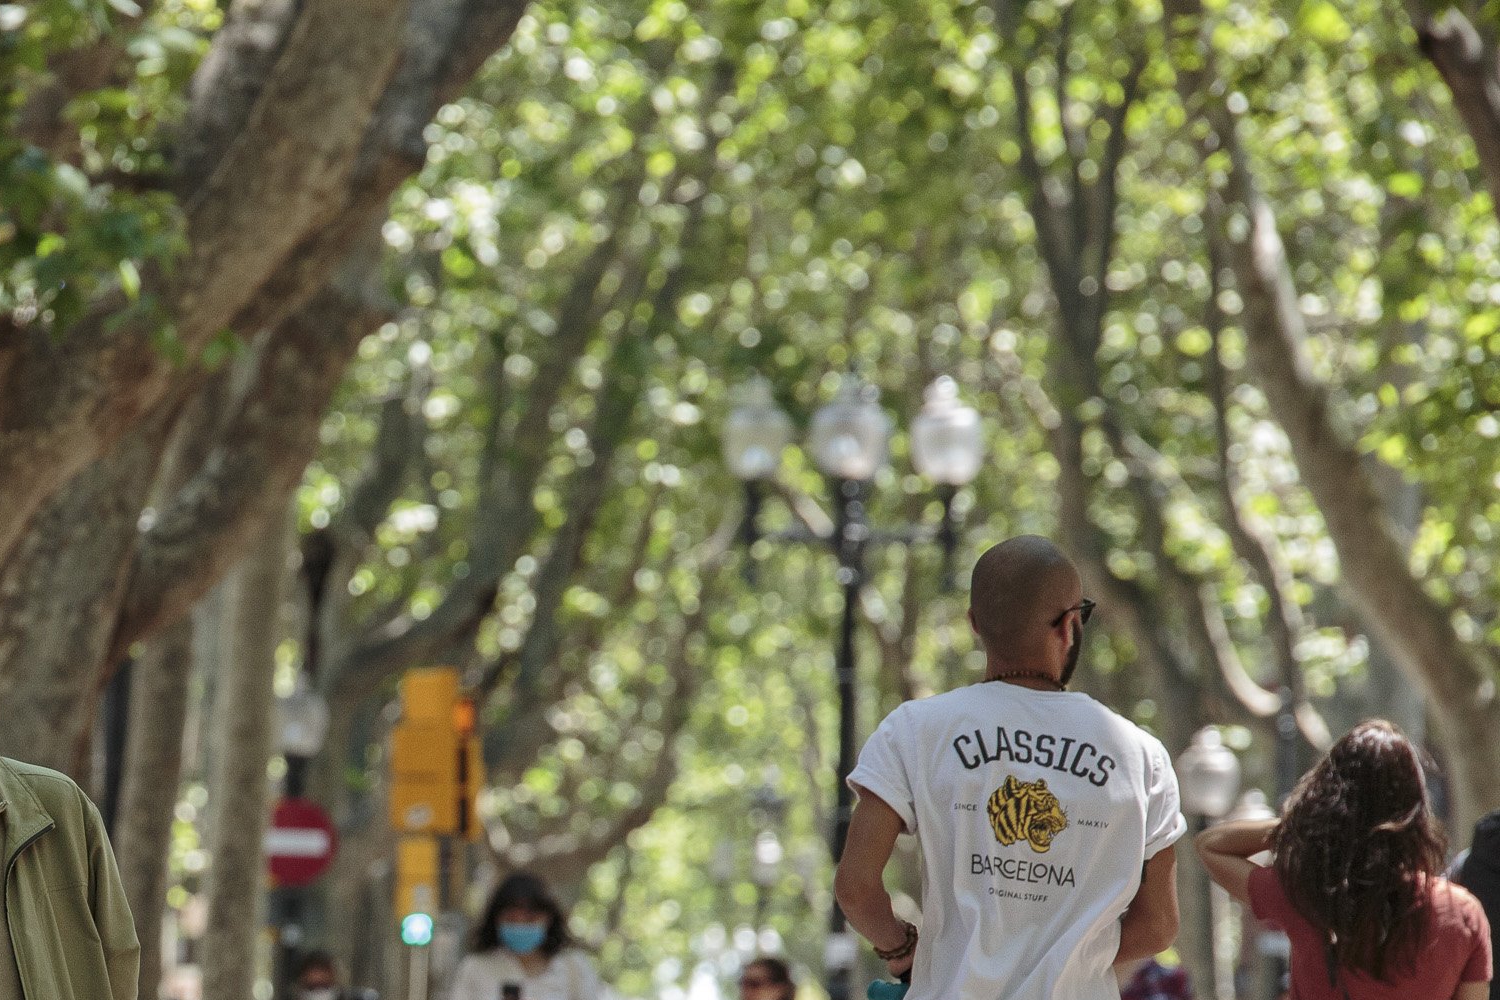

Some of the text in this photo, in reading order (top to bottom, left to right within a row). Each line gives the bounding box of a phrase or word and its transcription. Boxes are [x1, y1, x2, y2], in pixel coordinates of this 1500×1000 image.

[953, 726, 1116, 787] CLASSICS
[954, 802, 1110, 829] SINCE MMXIV
[971, 853, 1076, 888] BARCELONA
[1024, 892, 1049, 903] STUFF
